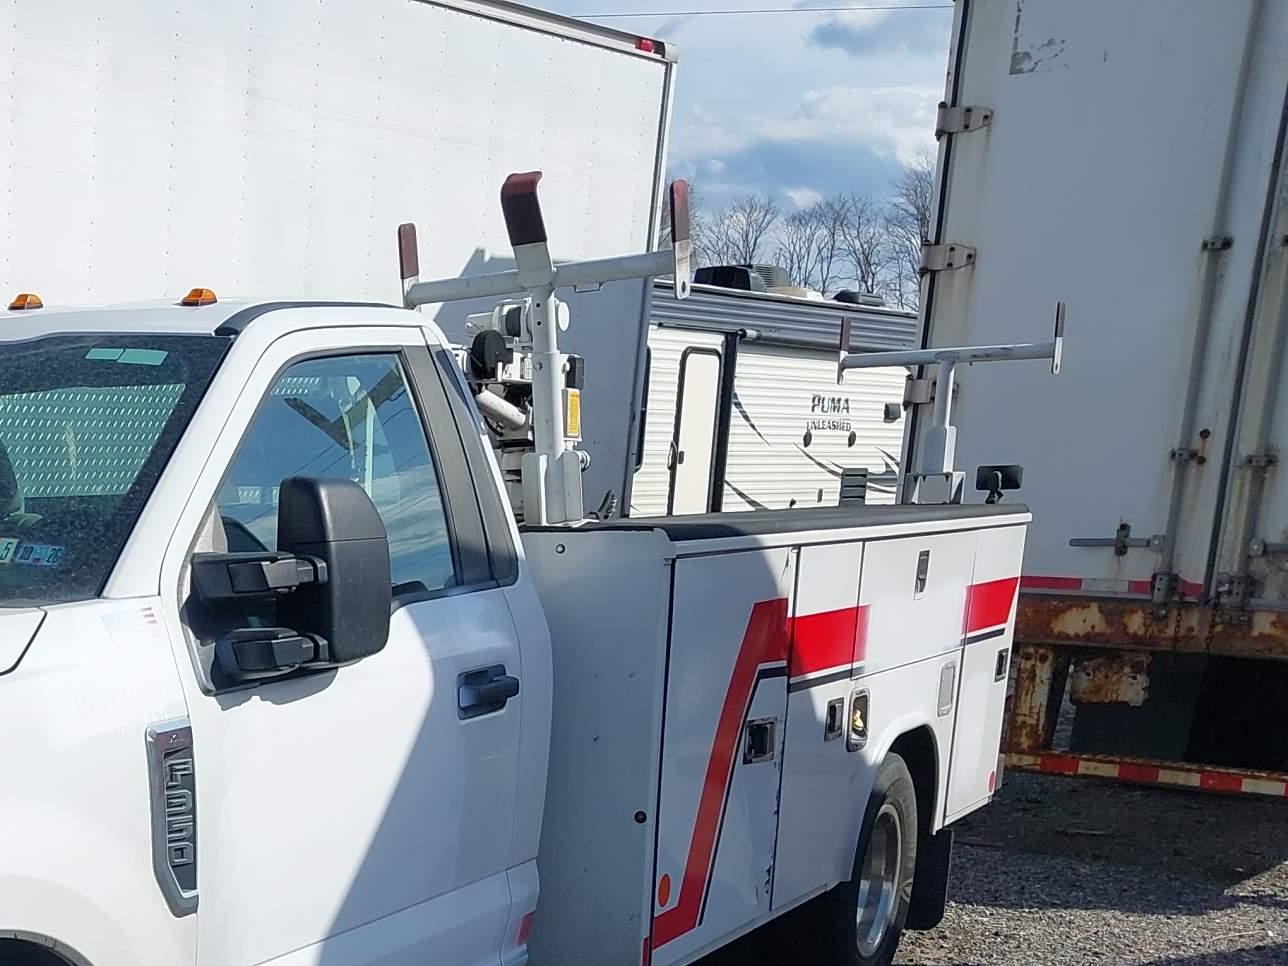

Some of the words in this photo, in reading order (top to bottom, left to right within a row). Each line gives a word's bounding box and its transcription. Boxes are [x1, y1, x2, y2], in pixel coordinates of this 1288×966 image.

[811, 394, 850, 414] PUMA
[806, 420, 852, 432] UNLEASHED
[0, 542, 13, 560] 5
